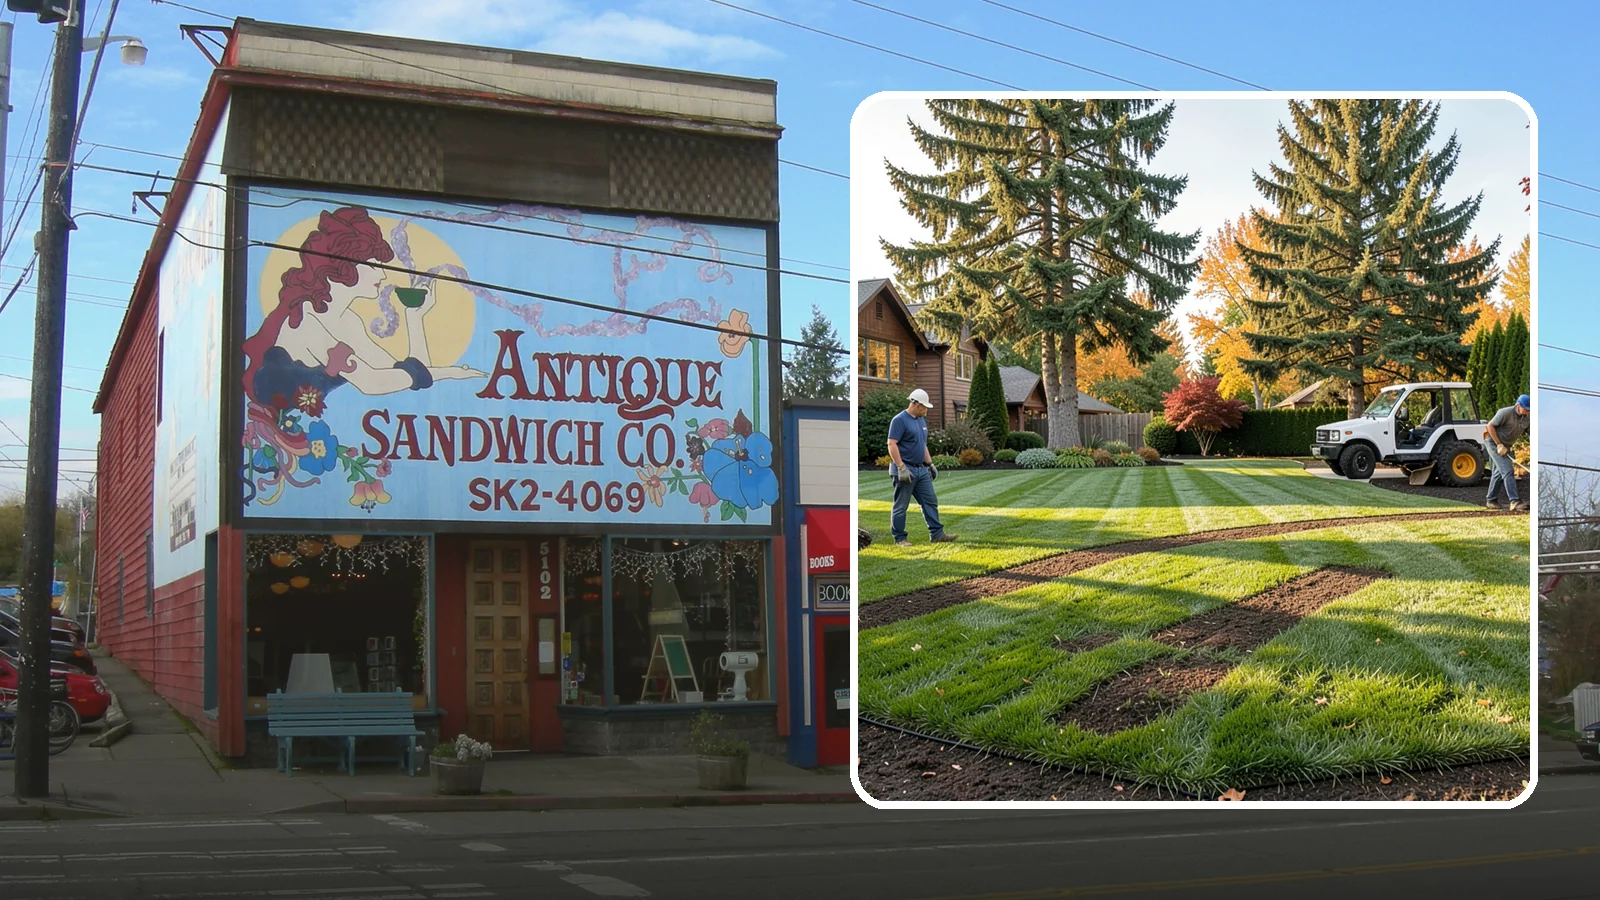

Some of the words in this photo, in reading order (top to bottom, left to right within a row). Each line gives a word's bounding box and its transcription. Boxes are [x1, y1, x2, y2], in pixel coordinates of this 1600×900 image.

[476, 328, 724, 421] ANTIQUE
[361, 408, 604, 467] SANDWICH
[616, 421, 685, 469] CO.
[468, 477, 646, 513] SK2-4069
[540, 542, 552, 600] 5102
[809, 555, 835, 569] BOOKS
